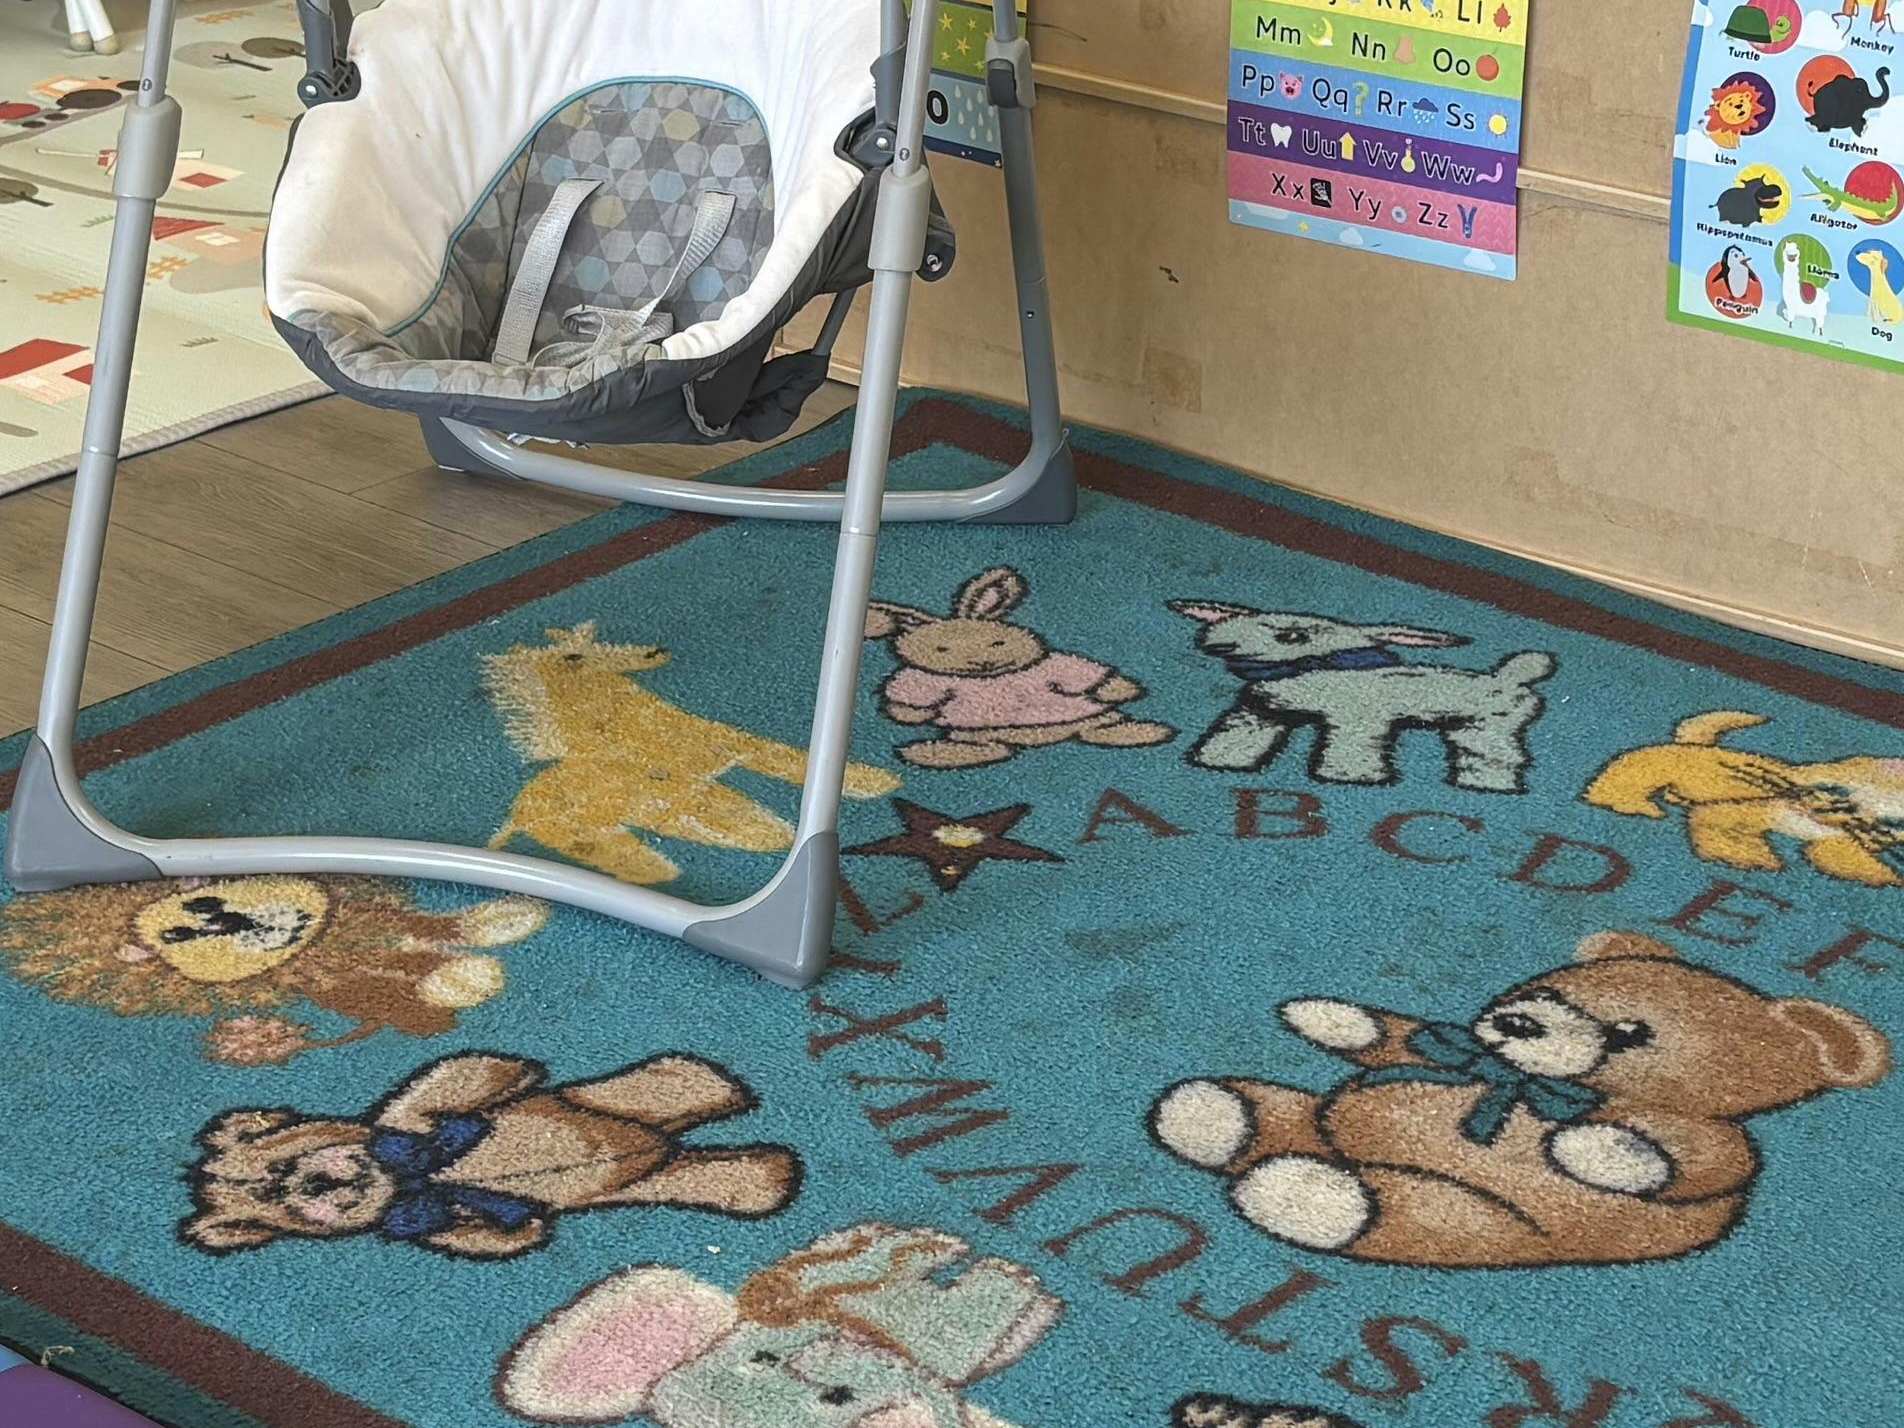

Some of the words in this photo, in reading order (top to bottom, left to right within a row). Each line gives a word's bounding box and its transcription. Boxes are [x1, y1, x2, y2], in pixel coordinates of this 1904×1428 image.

[1256, 16, 1302, 47] Mm
[1352, 32, 1386, 61] Nn
[1433, 47, 1471, 78] Oo
[1728, 47, 1760, 61] Turtle
[1850, 36, 1895, 55] Monkey
[1241, 65, 1275, 98] Pp
[1312, 77, 1348, 117] Qq
[1377, 90, 1406, 118] Rr
[1446, 102, 1476, 132] Ss
[1238, 116, 1267, 146] Tt
[1302, 129, 1337, 159] Uu
[1364, 141, 1398, 171] Vv
[1421, 153, 1476, 185] Ww
[1715, 154, 1737, 165] Lion
[1829, 138, 1878, 156] Elephant
[1271, 173, 1304, 201] Xx
[1348, 187, 1381, 221] Yy
[1417, 202, 1449, 230] Zz
[1810, 214, 1857, 229] Alligator
[1697, 222, 1773, 247] Hippopotamus
[1808, 264, 1839, 279] Llama
[1716, 298, 1758, 314] Penguin
[1871, 327, 1892, 341] Dog
[1076, 787, 1197, 846] A
[1232, 787, 1331, 840] B
[1371, 810, 1488, 865] C
[1507, 834, 1636, 894] D
[1657, 879, 1792, 947] E
[808, 996, 950, 1063] X
[845, 1073, 1011, 1158] W
[926, 1164, 1084, 1225] V
[1044, 1206, 1208, 1296] U
[1177, 1269, 1338, 1353] T
[1323, 1316, 1468, 1401] S
